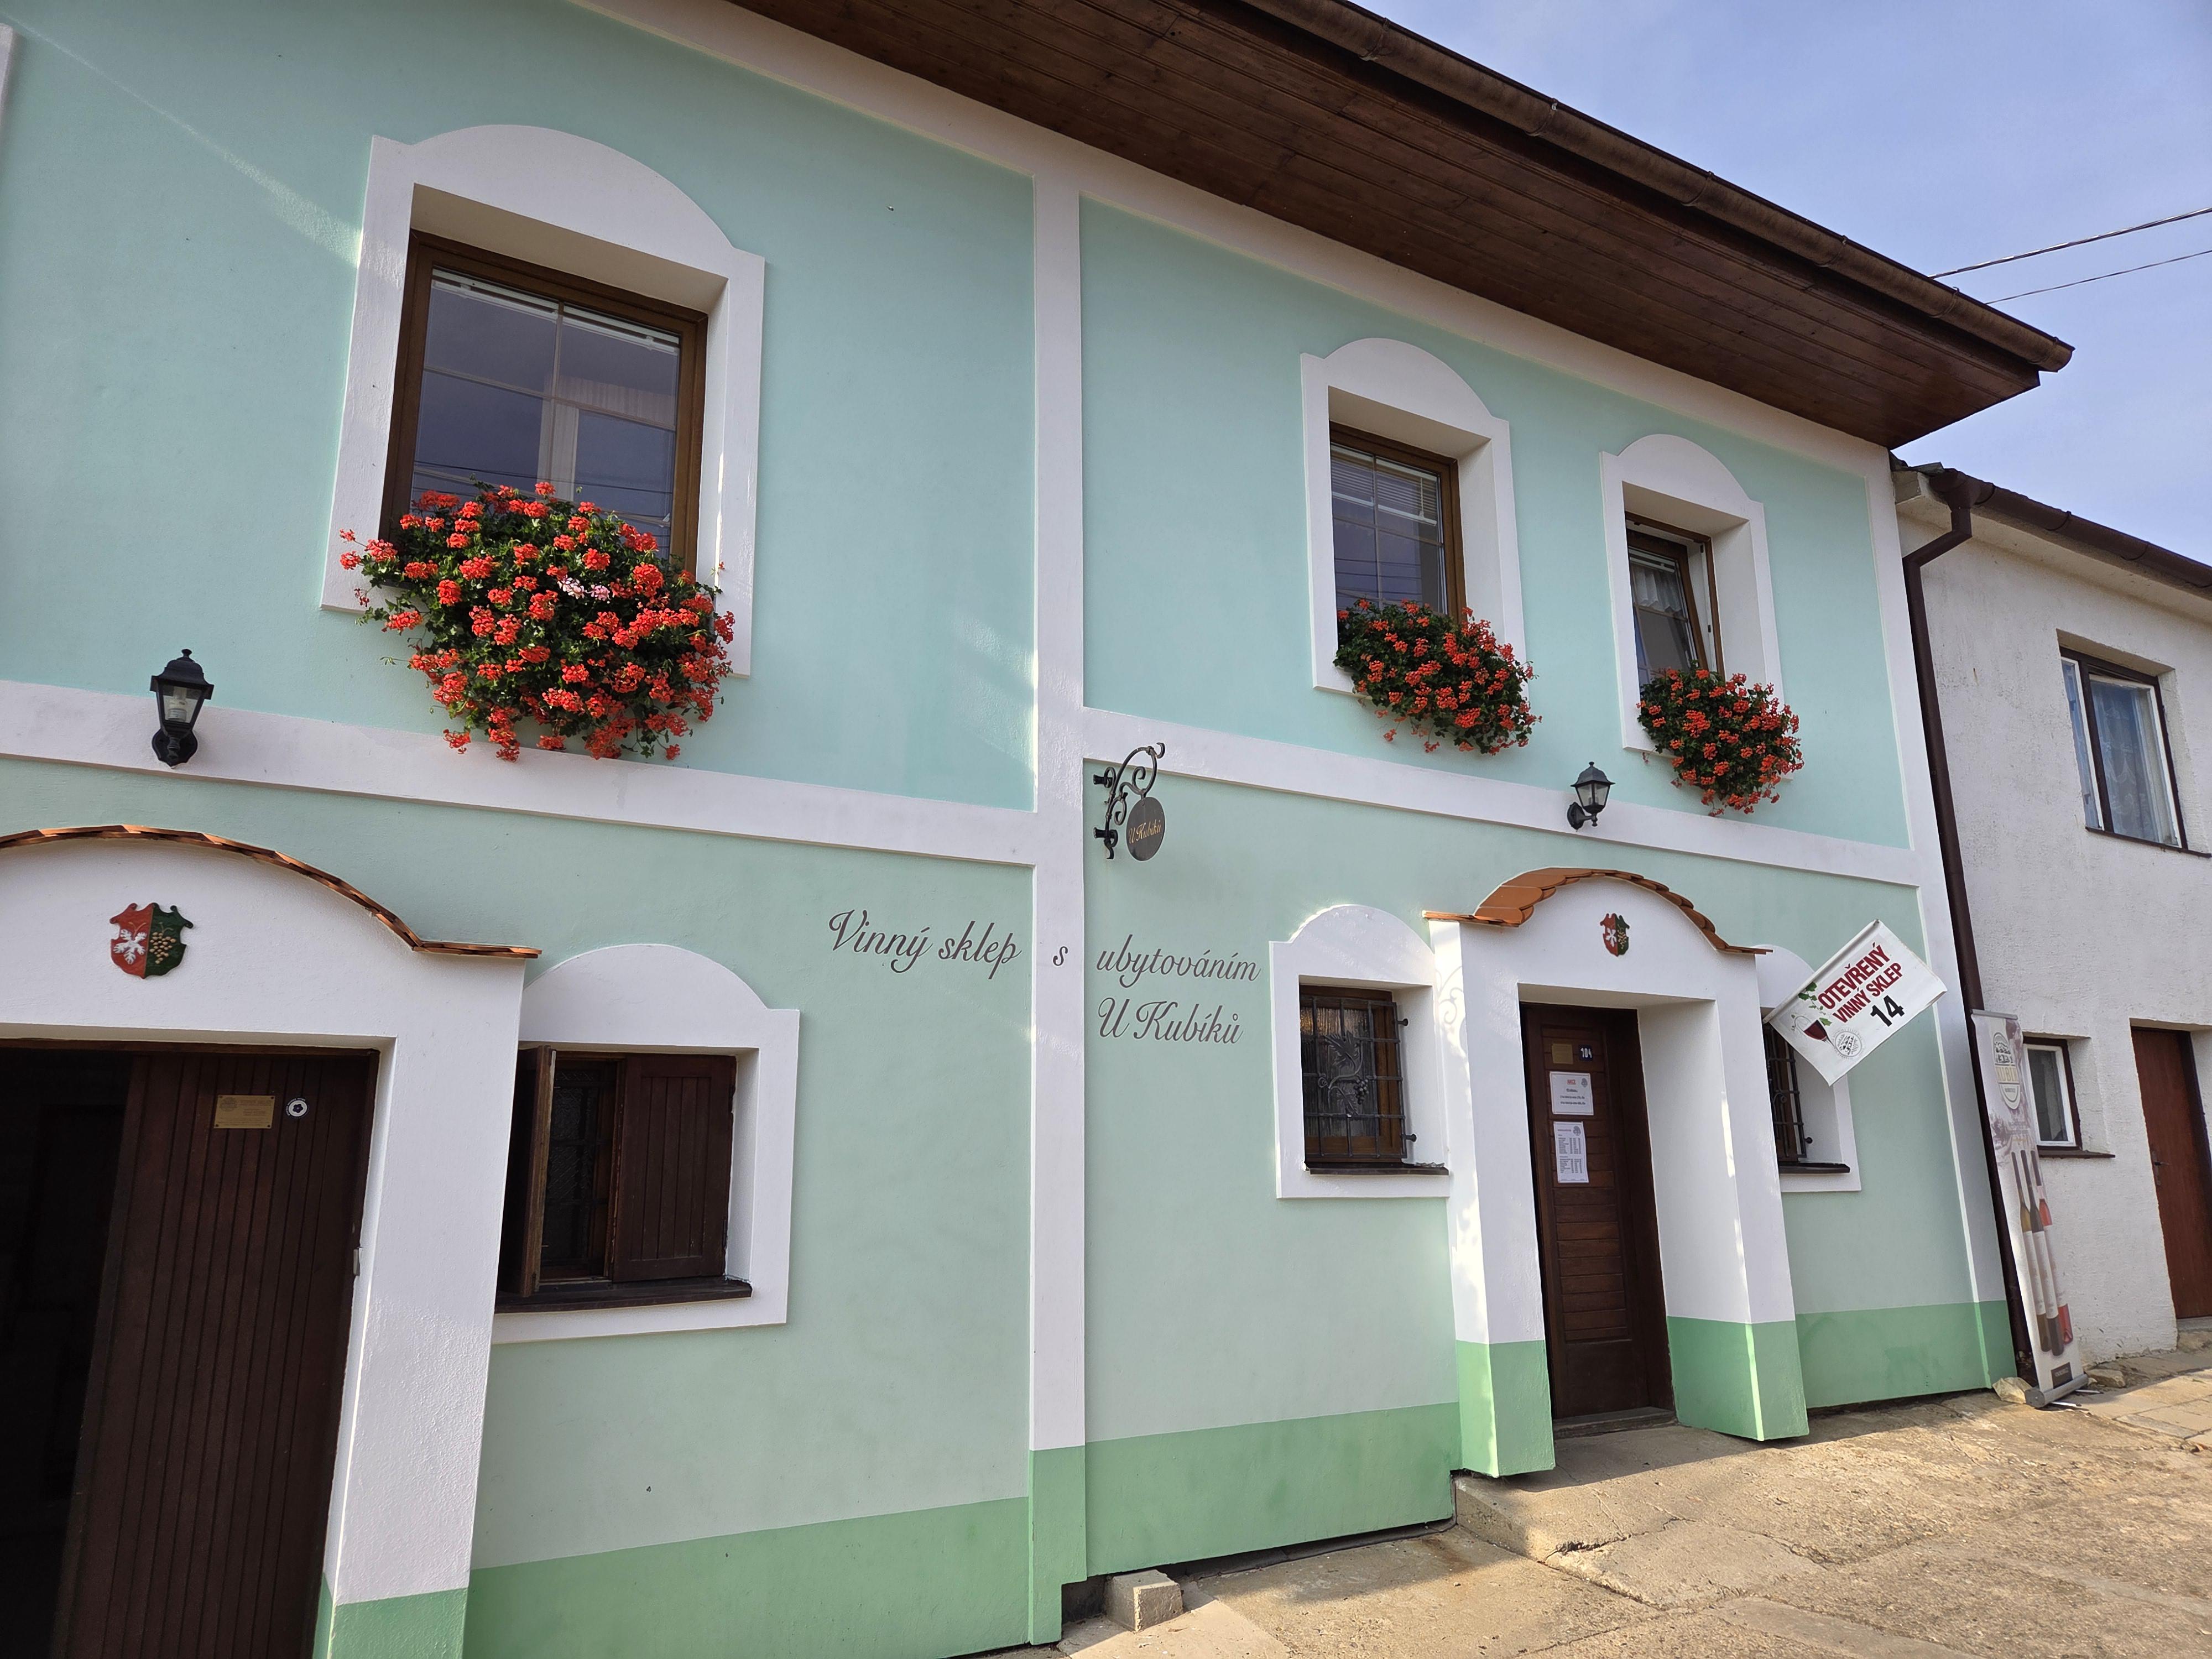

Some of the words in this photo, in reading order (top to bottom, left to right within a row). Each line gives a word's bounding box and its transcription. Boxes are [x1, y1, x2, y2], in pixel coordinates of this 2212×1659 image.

[1129, 827, 1136, 844] U
[828, 909, 933, 973] Vinný
[938, 921, 1022, 980] sklep
[1052, 945, 1067, 967] s
[1096, 934, 1261, 988] ubytováním
[1818, 942, 1891, 1010] OTEVŘENÝ
[1832, 987, 1871, 1024] VINNÝ
[1866, 962, 1903, 997] SKLEP
[1098, 997, 1130, 1038] U
[1133, 1000, 1244, 1044] Kubíků
[1870, 995, 1905, 1027] 14
[1580, 1047, 1593, 1058] 104
